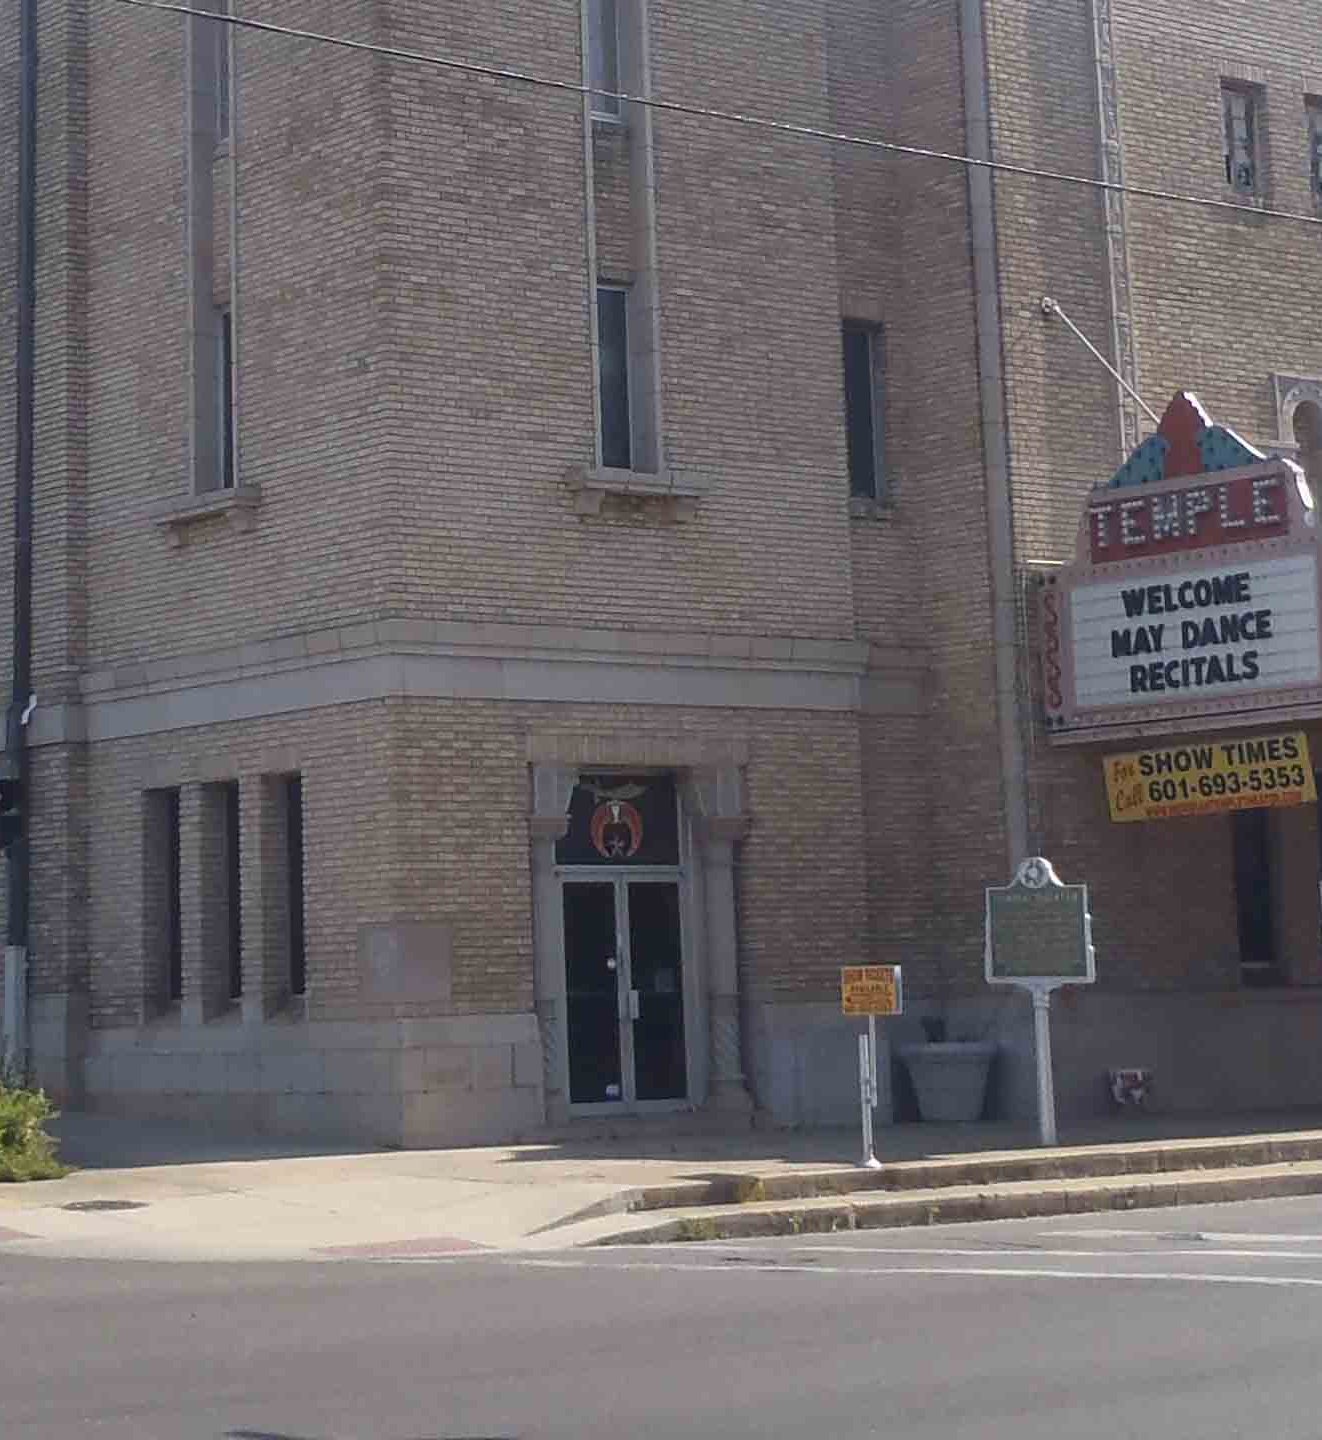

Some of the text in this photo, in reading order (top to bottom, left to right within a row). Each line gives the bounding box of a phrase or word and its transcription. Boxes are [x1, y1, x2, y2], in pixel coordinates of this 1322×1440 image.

[1090, 478, 1280, 548] TEMPLE
[1121, 571, 1252, 618] WELCOME
[1110, 610, 1273, 659] MAY DANCE
[1130, 651, 1260, 693] RECITALS
[1138, 746, 1214, 776] SHOW
[1221, 736, 1299, 766] TIMES
[1148, 764, 1305, 802] 601-693-5353
